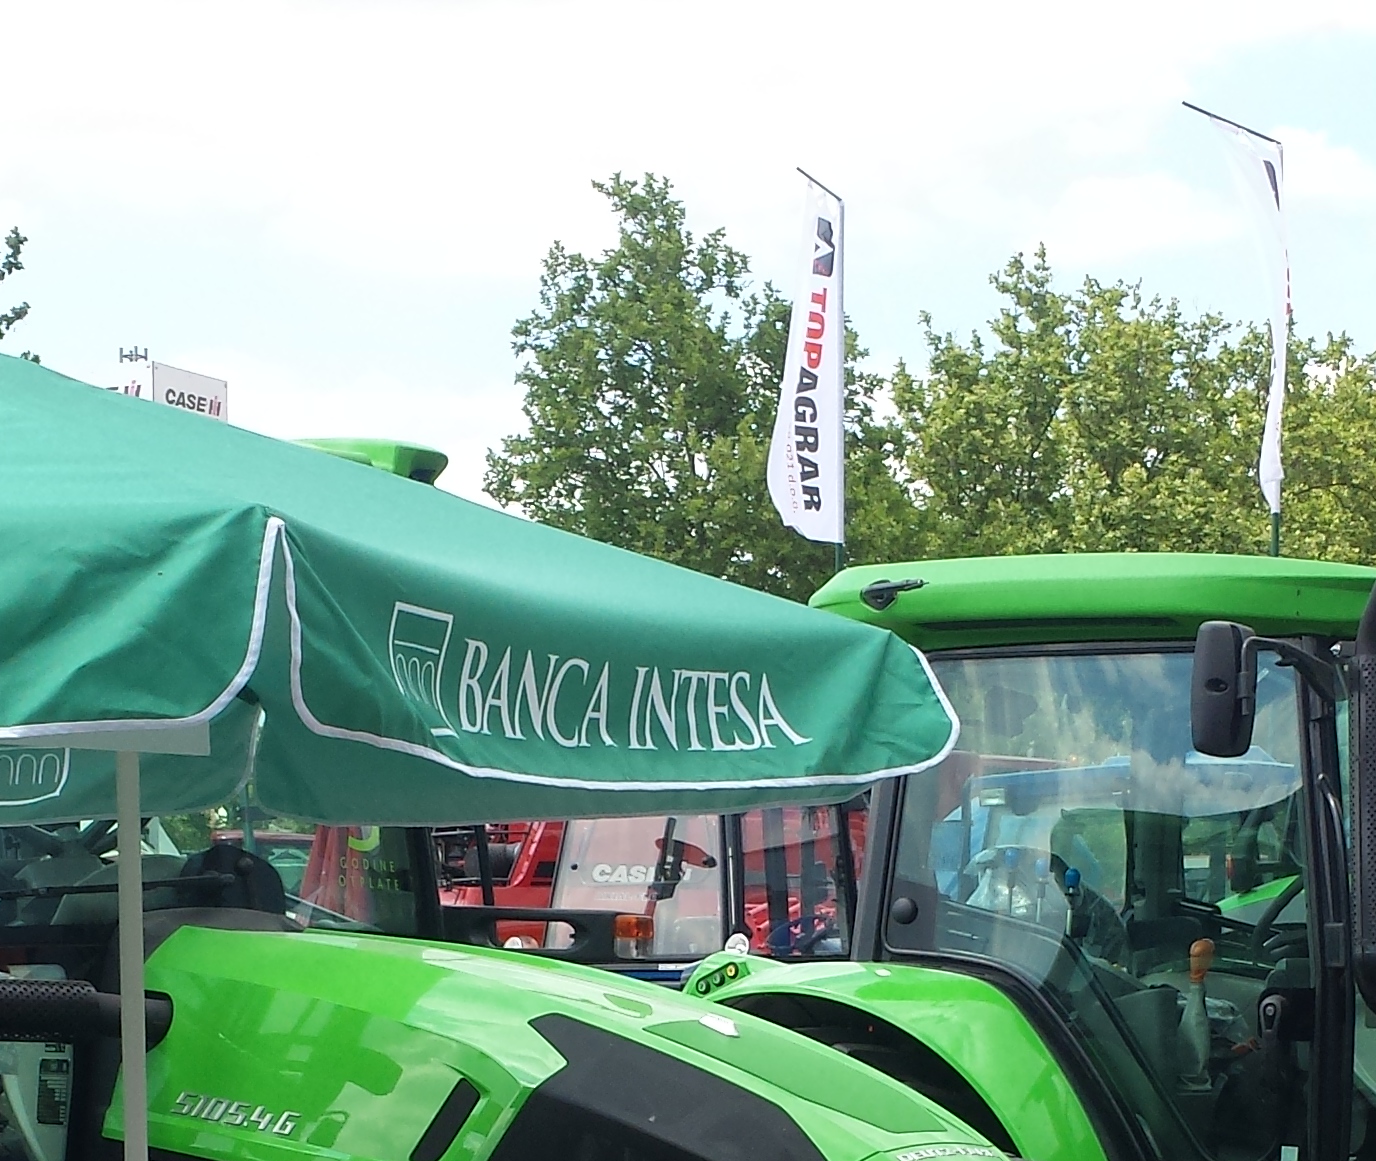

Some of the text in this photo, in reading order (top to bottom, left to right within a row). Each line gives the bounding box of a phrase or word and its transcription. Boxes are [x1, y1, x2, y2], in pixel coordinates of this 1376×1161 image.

[165, 388, 207, 413] CASE
[458, 637, 813, 752] BANCA INTESA
